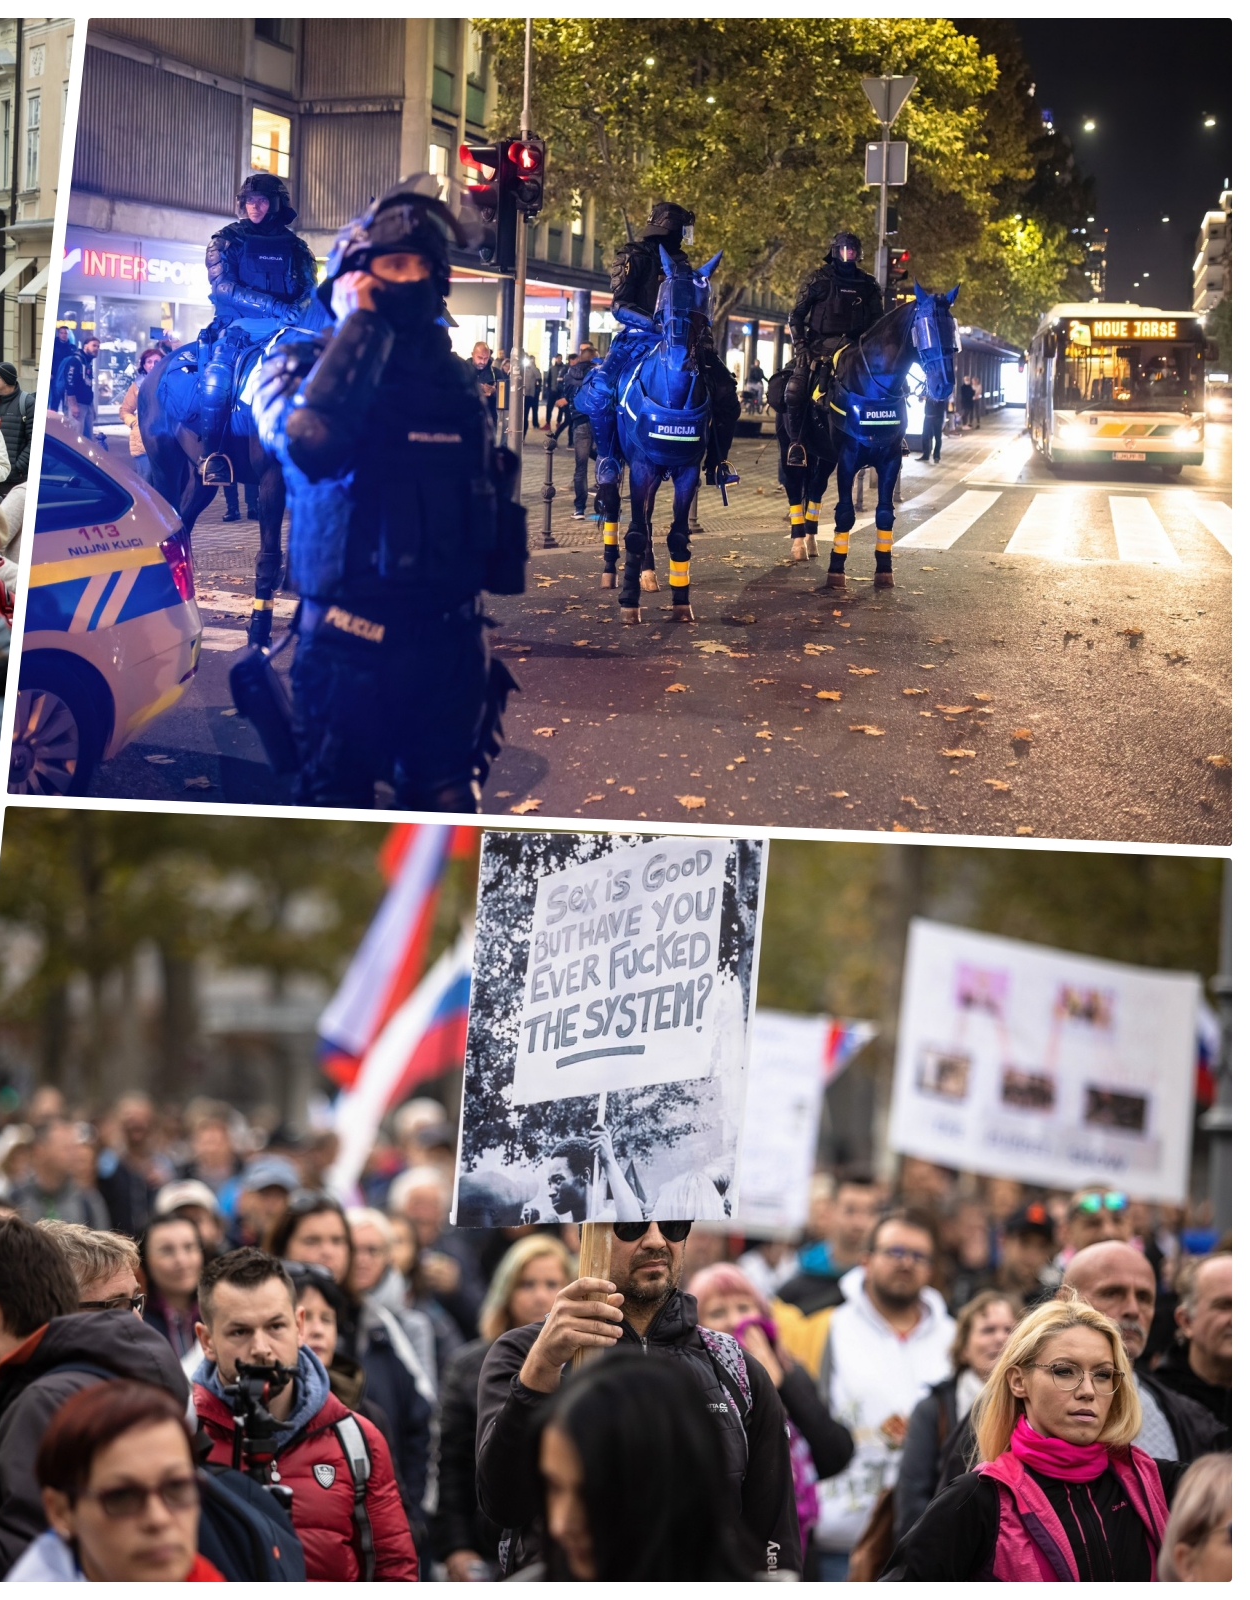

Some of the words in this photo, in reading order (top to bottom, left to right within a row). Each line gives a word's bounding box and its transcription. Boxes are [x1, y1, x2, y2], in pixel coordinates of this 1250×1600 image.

[1094, 321, 1128, 337] NOVE
[866, 411, 897, 419] POLICIJA
[657, 425, 696, 435] POLICIJA
[78, 524, 120, 541] 113
[68, 542, 110, 556] NUJNI
[112, 538, 144, 550] KLICI
[651, 887, 717, 932] YOU
[530, 953, 601, 1004] EVER
[523, 1003, 581, 1054] THE
[582, 972, 714, 1039] SYSTEM?
